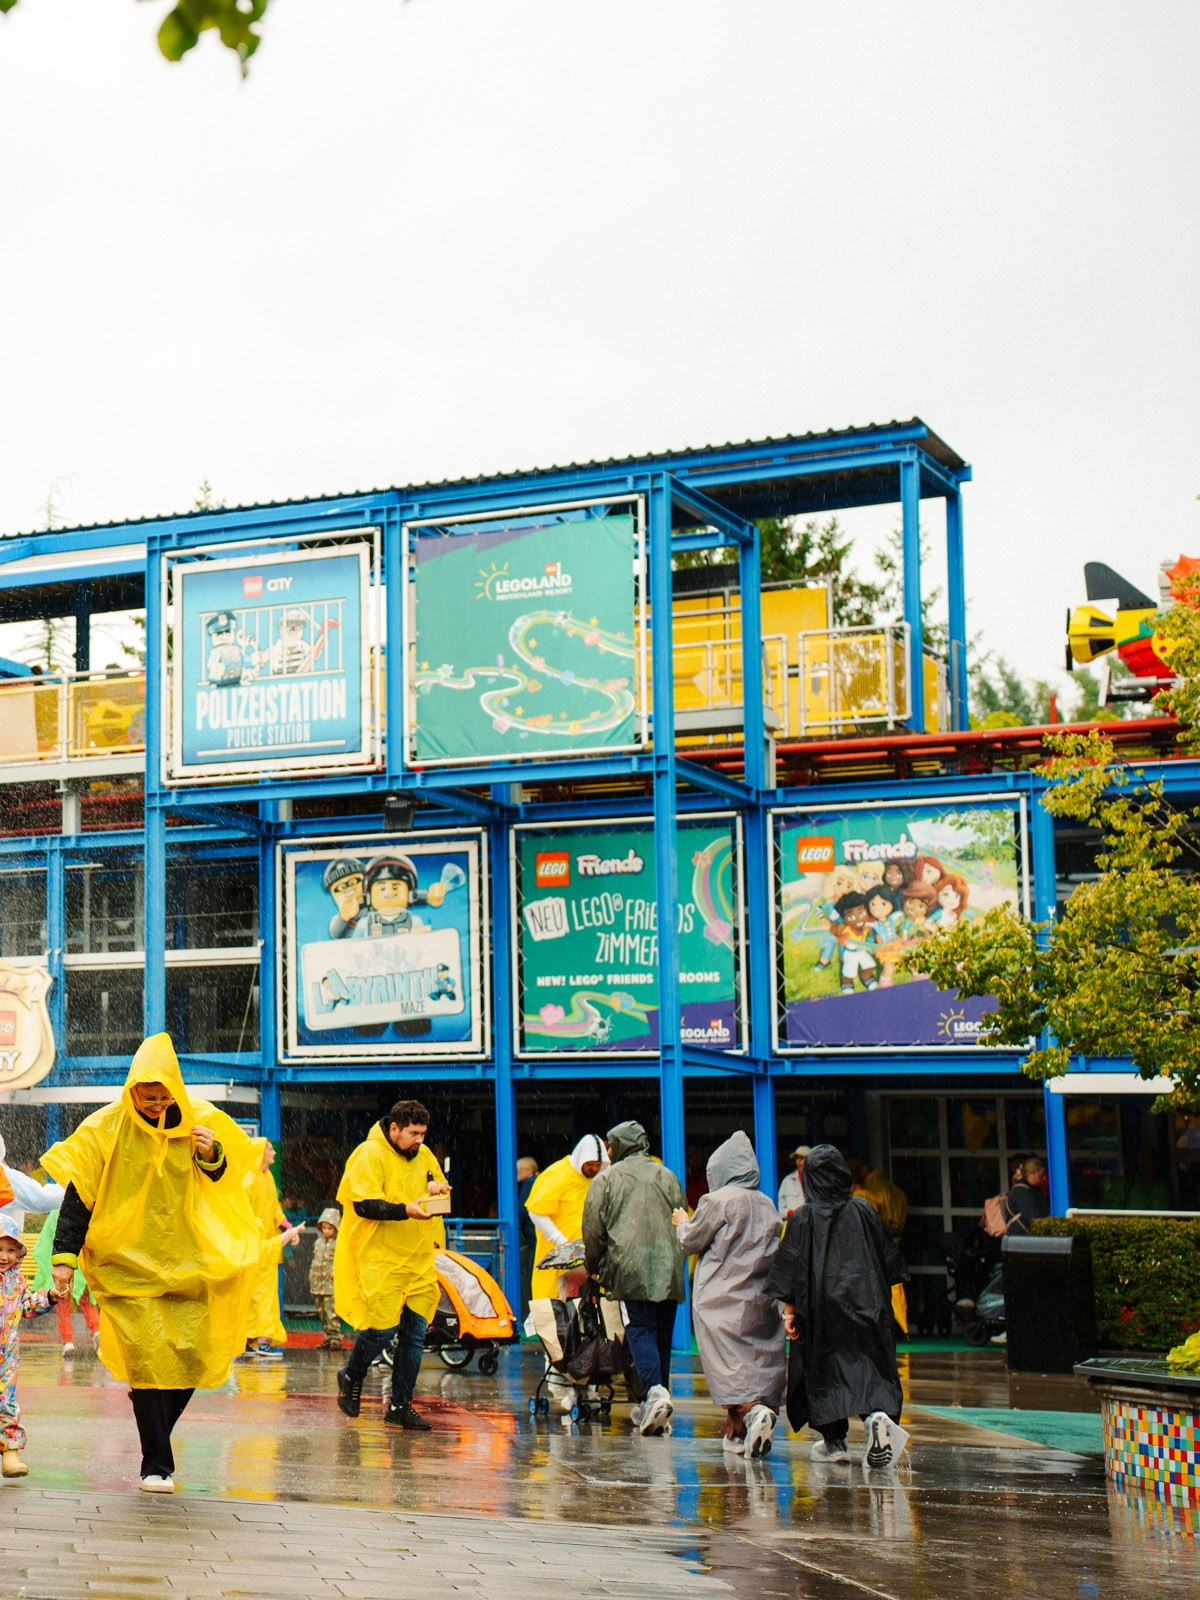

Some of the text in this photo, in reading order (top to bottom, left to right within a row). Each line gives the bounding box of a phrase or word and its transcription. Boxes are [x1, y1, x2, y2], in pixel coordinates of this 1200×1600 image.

[495, 562, 572, 593] LEGOLAND
[196, 678, 347, 731] POLIZEISTATION
[227, 722, 311, 748] POLICE STATION
[800, 832, 918, 862] LEGO Friends
[539, 848, 644, 876] LEGO Friends
[530, 902, 564, 934] NEU
[537, 975, 566, 988] NEW!
[607, 973, 654, 985] FRIENDS
[401, 1000, 426, 1015] MAZE
[680, 1019, 731, 1038] EGOLAND
